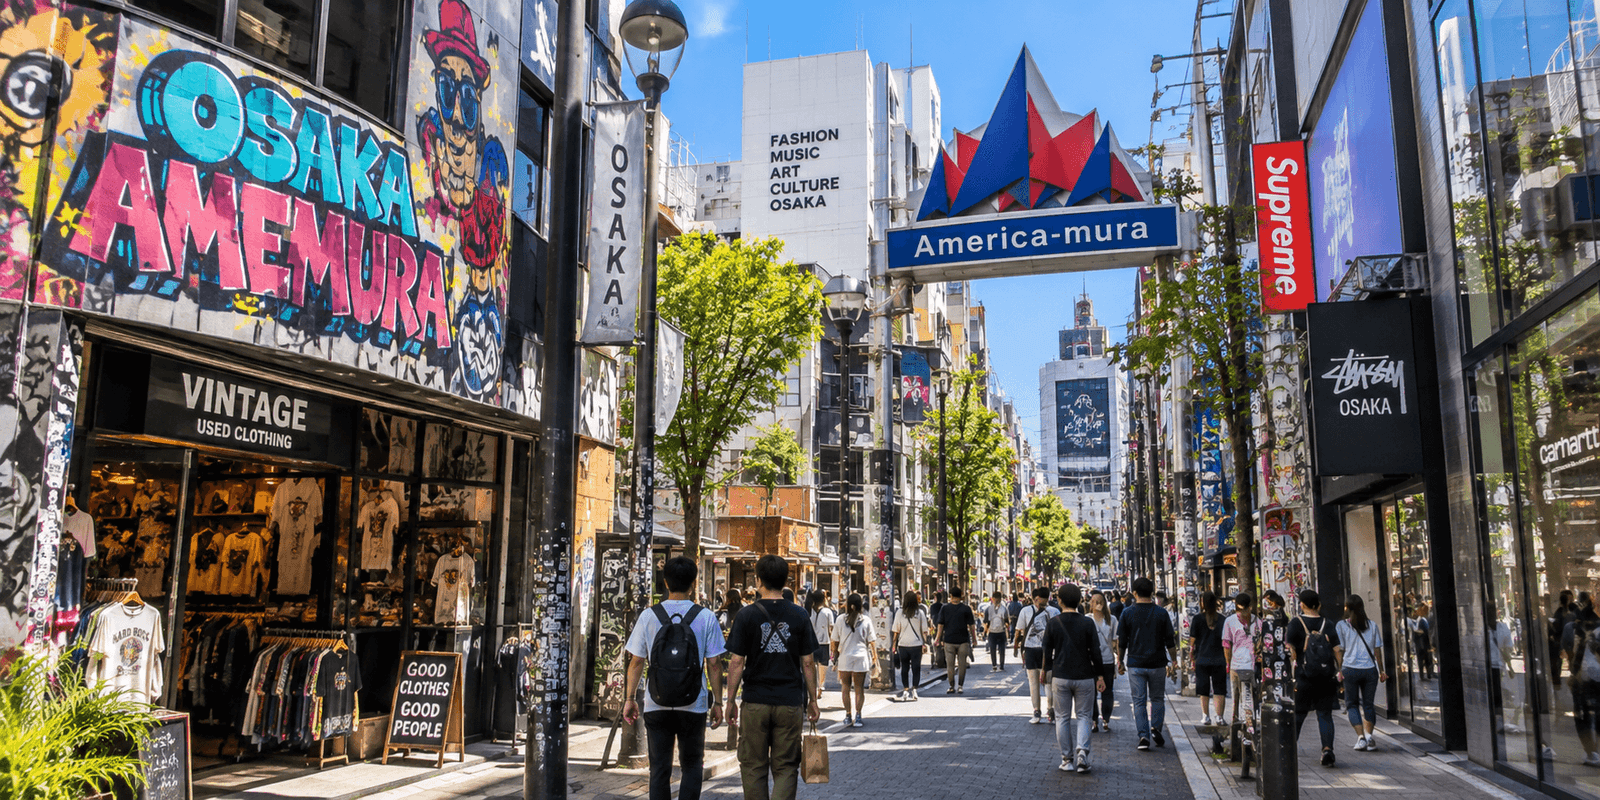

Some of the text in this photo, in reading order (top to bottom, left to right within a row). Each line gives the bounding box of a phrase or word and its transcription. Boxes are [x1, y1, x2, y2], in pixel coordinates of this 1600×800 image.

[770, 127, 839, 148] FASHION
[159, 57, 420, 239] OSAKA
[770, 146, 821, 164] MUSIC
[769, 164, 801, 180] ART
[769, 176, 840, 196] CULTURE
[769, 194, 827, 212] OSAKA
[602, 143, 629, 306] OSAKA
[1258, 155, 1299, 296] Supreme
[67, 141, 452, 350] AMEMURA
[913, 220, 1149, 259] America-mura
[181, 371, 309, 433] VINTAGE
[1339, 397, 1393, 417] OSAKA
[196, 417, 293, 450] USED CLOTHING
[406, 661, 448, 678] GOOD
[399, 680, 450, 697] CLOTHES
[400, 700, 441, 718] GOOD
[392, 719, 443, 739] PEOPLE
